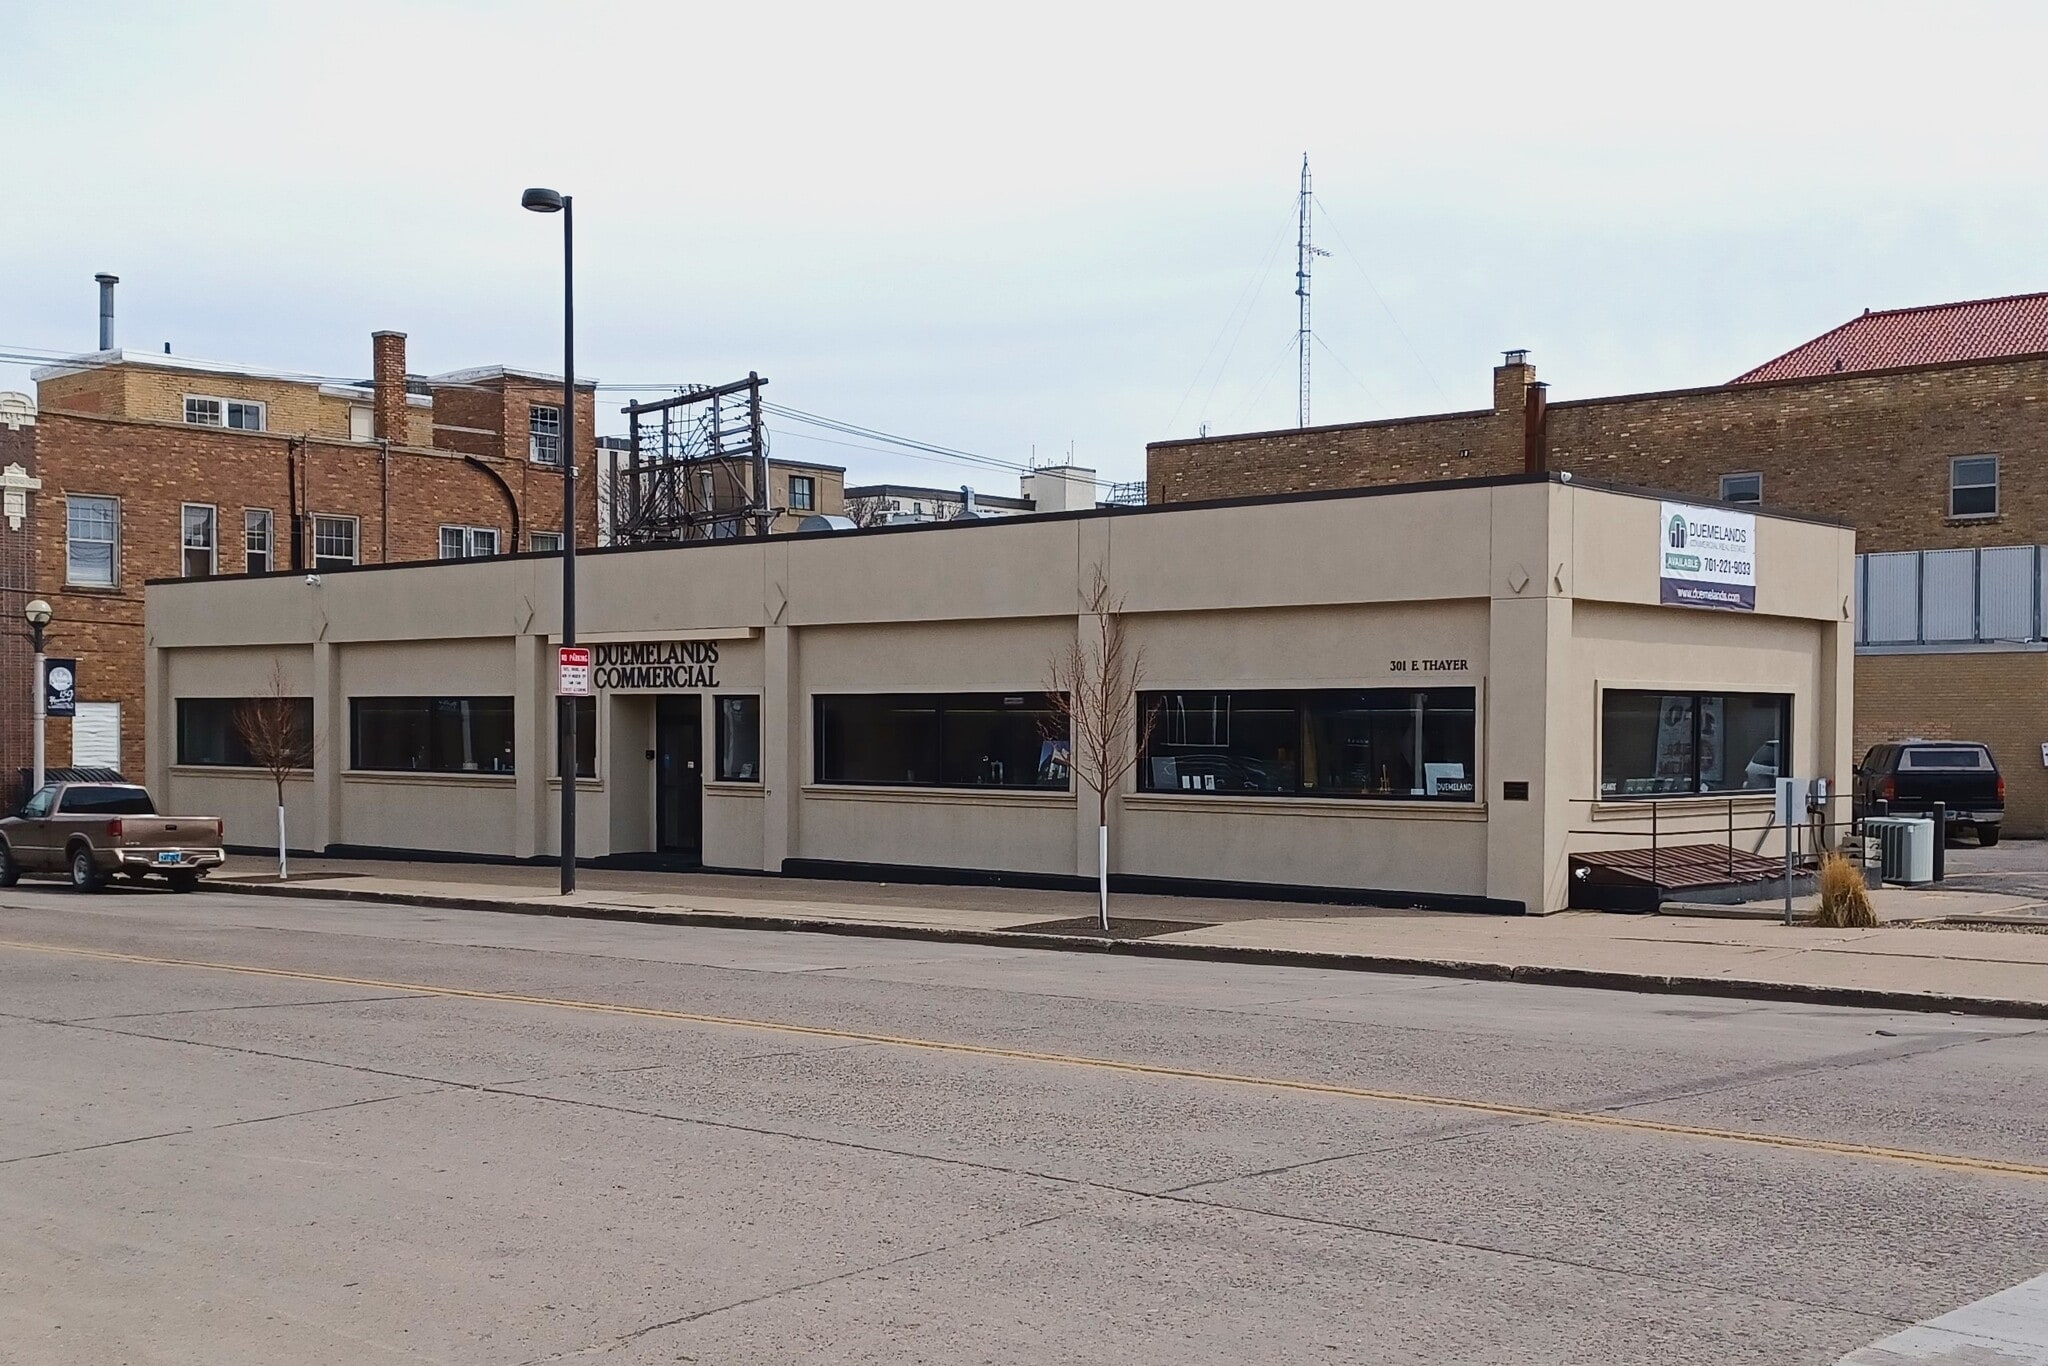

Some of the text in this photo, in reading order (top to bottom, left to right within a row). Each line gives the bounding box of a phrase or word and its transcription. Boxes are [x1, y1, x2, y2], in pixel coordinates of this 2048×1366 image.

[1689, 522, 1747, 543] DUEMELANDS
[1667, 556, 1699, 569] AVAILABLE
[1704, 557, 1751, 576] 701-221-9033
[1676, 588, 1740, 602] www.duemelands.com
[594, 641, 719, 666] DUEMELANDS
[1390, 660, 1406, 671] 301
[1422, 659, 1468, 671] THAYER
[594, 665, 720, 689] COMMERCIAL
